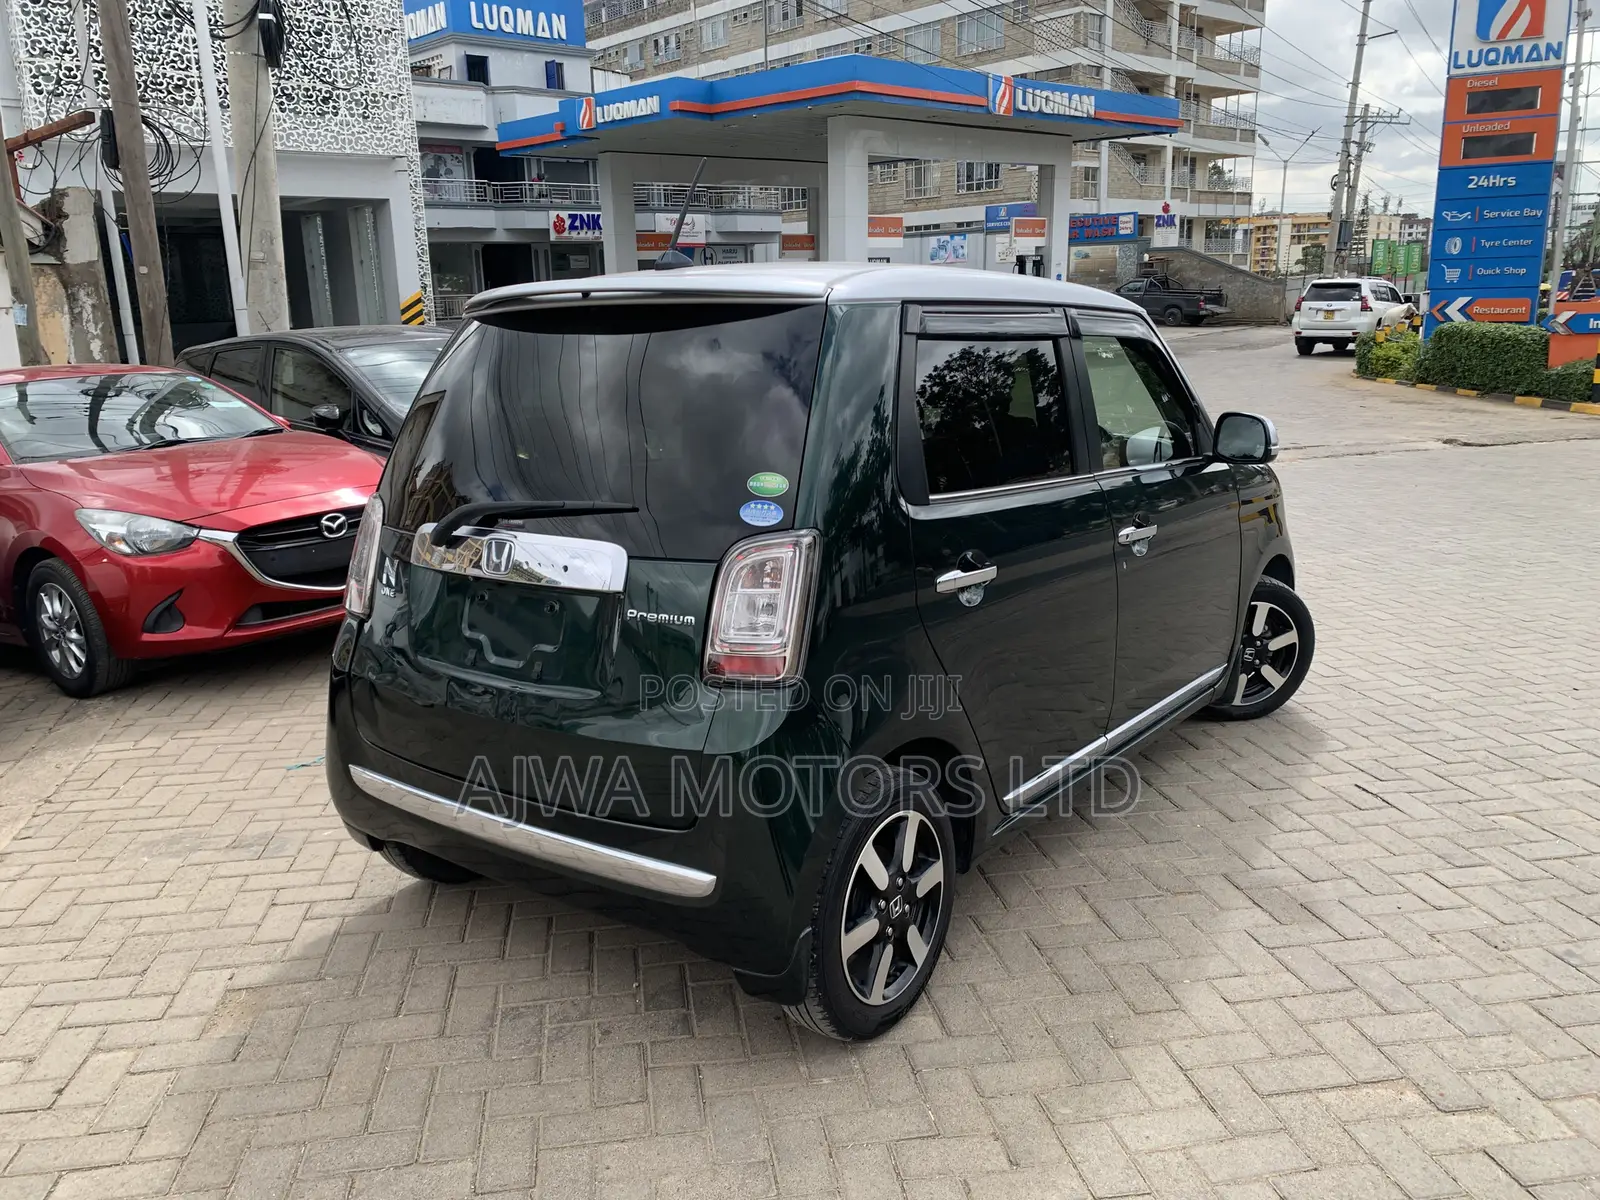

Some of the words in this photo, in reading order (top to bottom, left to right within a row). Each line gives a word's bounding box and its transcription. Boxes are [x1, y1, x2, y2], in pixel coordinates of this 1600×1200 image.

[404, 1, 448, 40] QMAN
[469, 1, 567, 40] LUQMAN
[1453, 41, 1563, 69] LUQMAN
[1467, 78, 1498, 88] Diesel
[1015, 86, 1096, 118] LUQMAN
[596, 95, 660, 124] LUQMAN
[1462, 121, 1511, 133] Unleaded
[1467, 174, 1517, 189] 24Hrs
[1483, 209, 1521, 219] Service
[1523, 207, 1544, 218] Bay
[567, 213, 603, 231] ZNK
[1069, 216, 1117, 228] ECUTIVE
[1155, 214, 1177, 228] ZNK
[1481, 240, 1500, 249] Tyre
[1502, 238, 1534, 246] Center
[1477, 267, 1501, 275] Quick
[1503, 266, 1527, 275] Shop
[1473, 305, 1526, 315] Restaurant
[380, 586, 397, 598] ONE
[626, 608, 696, 626] Premium
